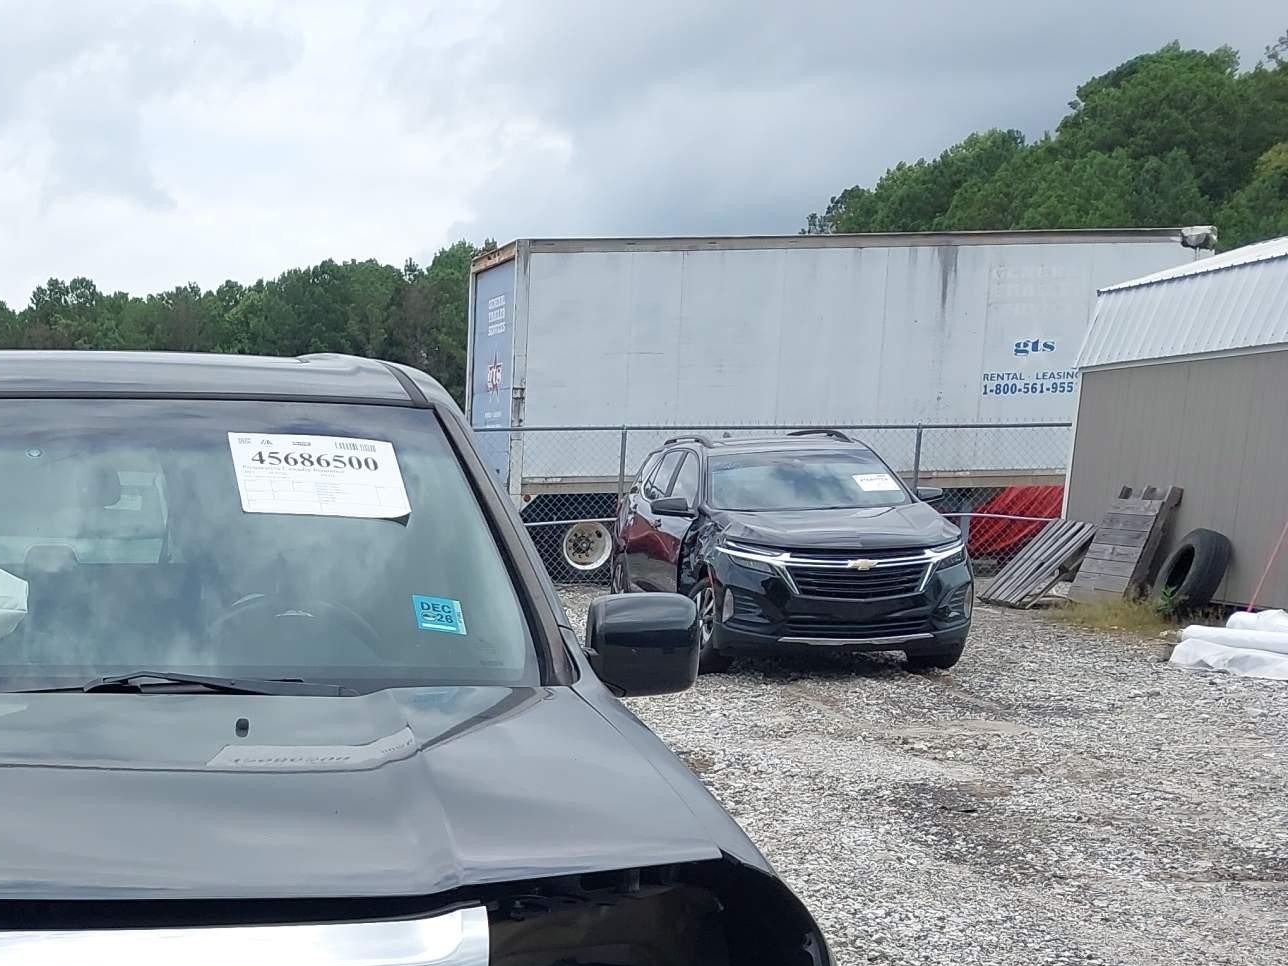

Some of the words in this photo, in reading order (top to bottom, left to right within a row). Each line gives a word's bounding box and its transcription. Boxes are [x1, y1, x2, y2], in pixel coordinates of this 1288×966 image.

[1014, 339, 1055, 356] gts
[983, 373, 1025, 381] RENTAL
[251, 450, 379, 471] 45686500
[421, 601, 452, 614] DEC
